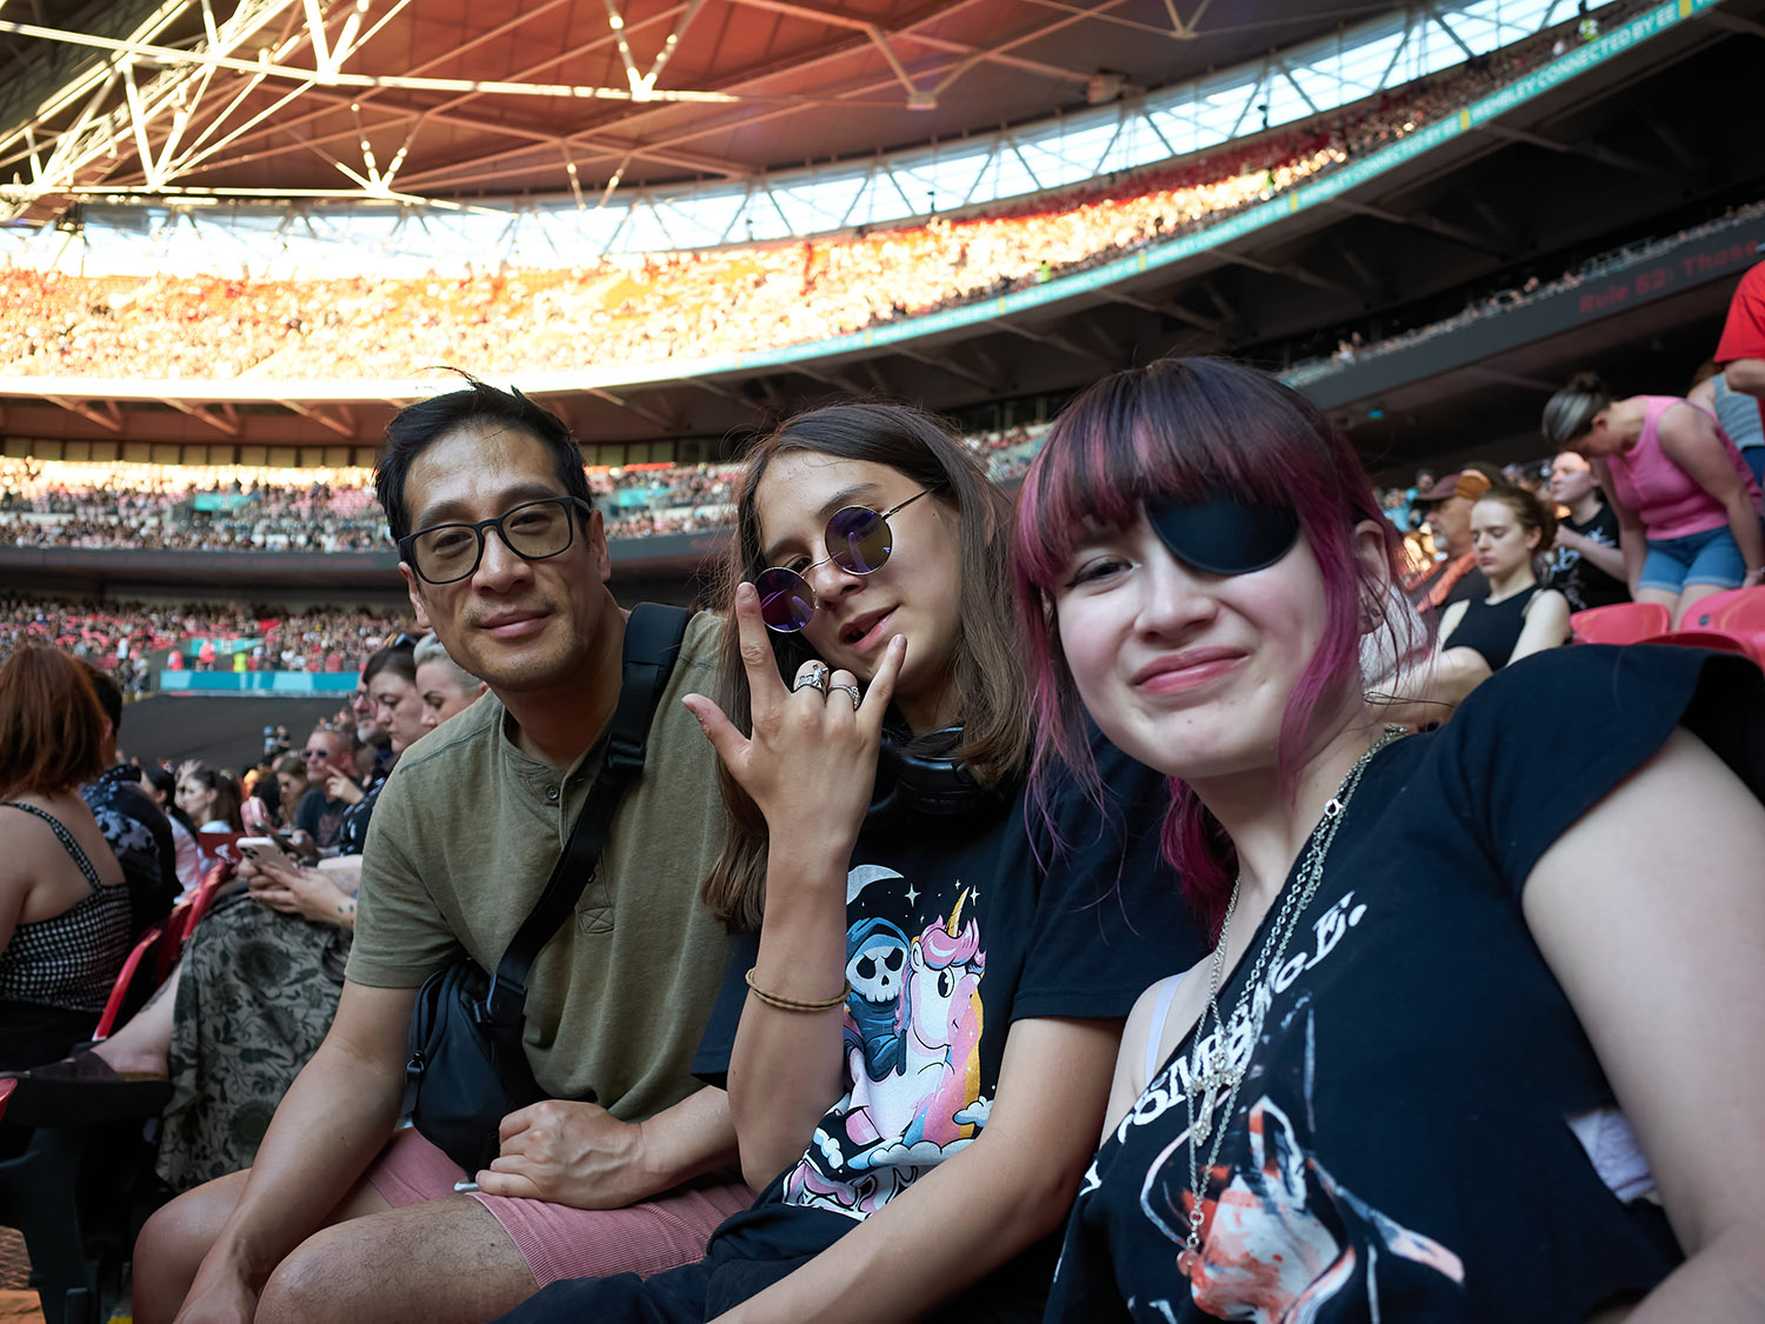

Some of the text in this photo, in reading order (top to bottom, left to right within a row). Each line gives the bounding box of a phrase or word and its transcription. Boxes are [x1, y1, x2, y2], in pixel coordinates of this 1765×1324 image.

[1536, 27, 1631, 90] CONNECTED
[1631, 14, 1656, 41] BY
[1656, 3, 1677, 28] EE
